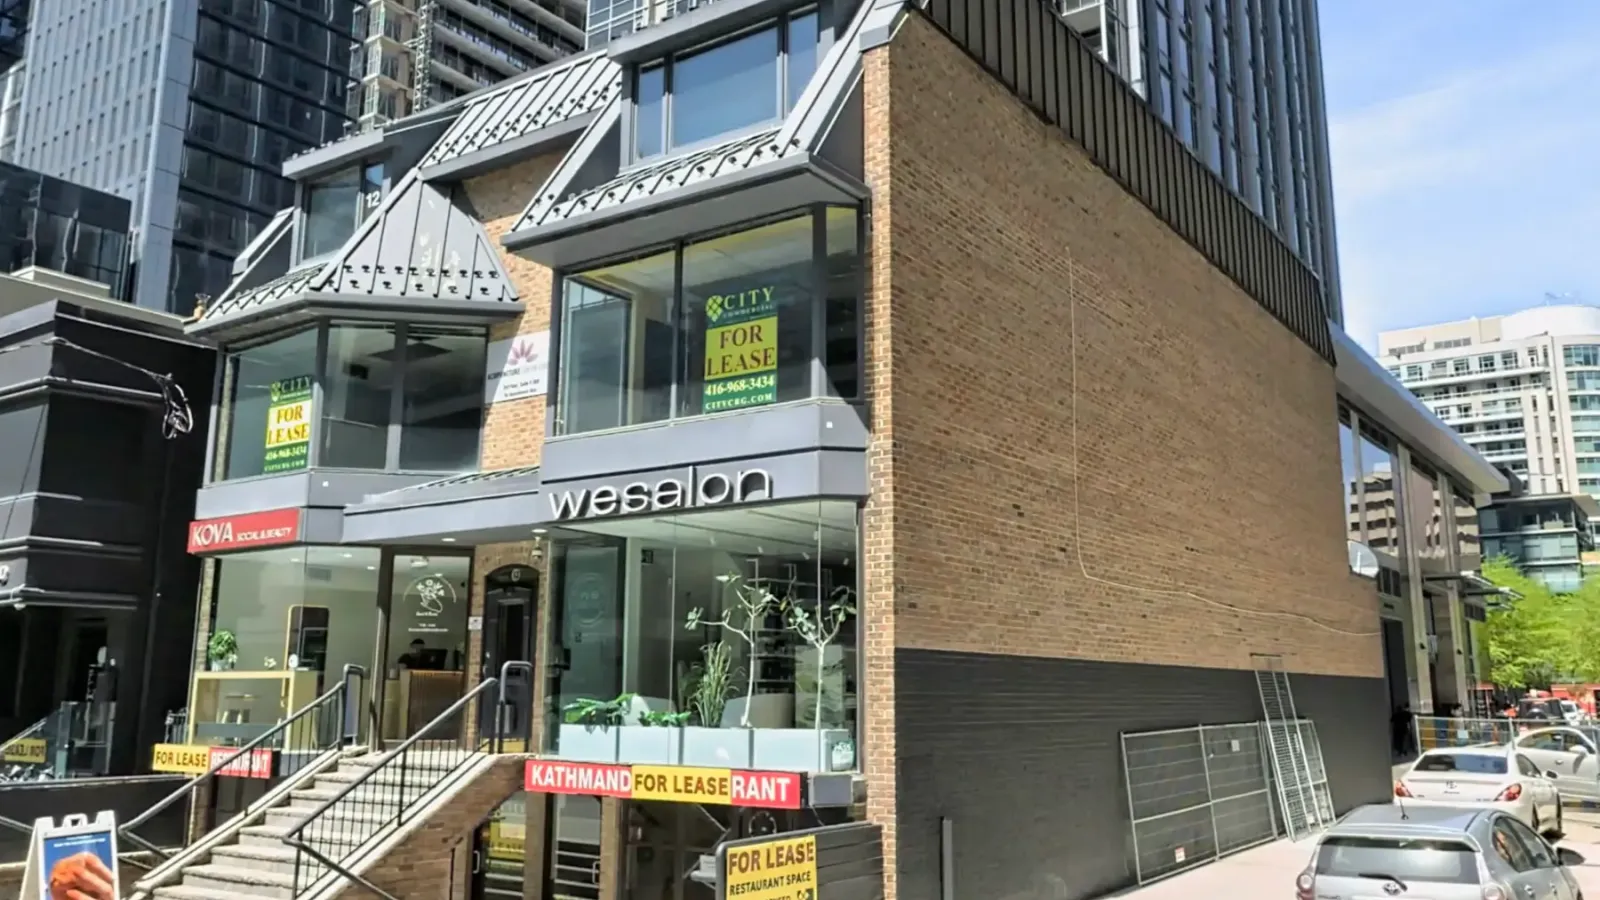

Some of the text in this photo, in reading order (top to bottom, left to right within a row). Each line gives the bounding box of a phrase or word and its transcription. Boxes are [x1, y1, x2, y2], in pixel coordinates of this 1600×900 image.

[366, 190, 380, 208] 12
[724, 286, 774, 310] CITY
[720, 324, 763, 349] FOR
[707, 347, 775, 377] LEASE
[281, 376, 312, 393] CITY
[705, 375, 774, 396] 416-968-3434
[276, 404, 303, 424] FOR
[267, 423, 310, 445] LEASE
[548, 465, 772, 521] wesalon
[192, 521, 233, 546] KOVA
[156, 750, 206, 768] FOR LEASE
[532, 764, 632, 793] KATHMAND
[634, 773, 729, 796] FOR LEASE
[731, 775, 792, 802] RANT
[728, 841, 814, 876] FOR LEASE
[729, 870, 811, 896] RESTAURANT SPACE
